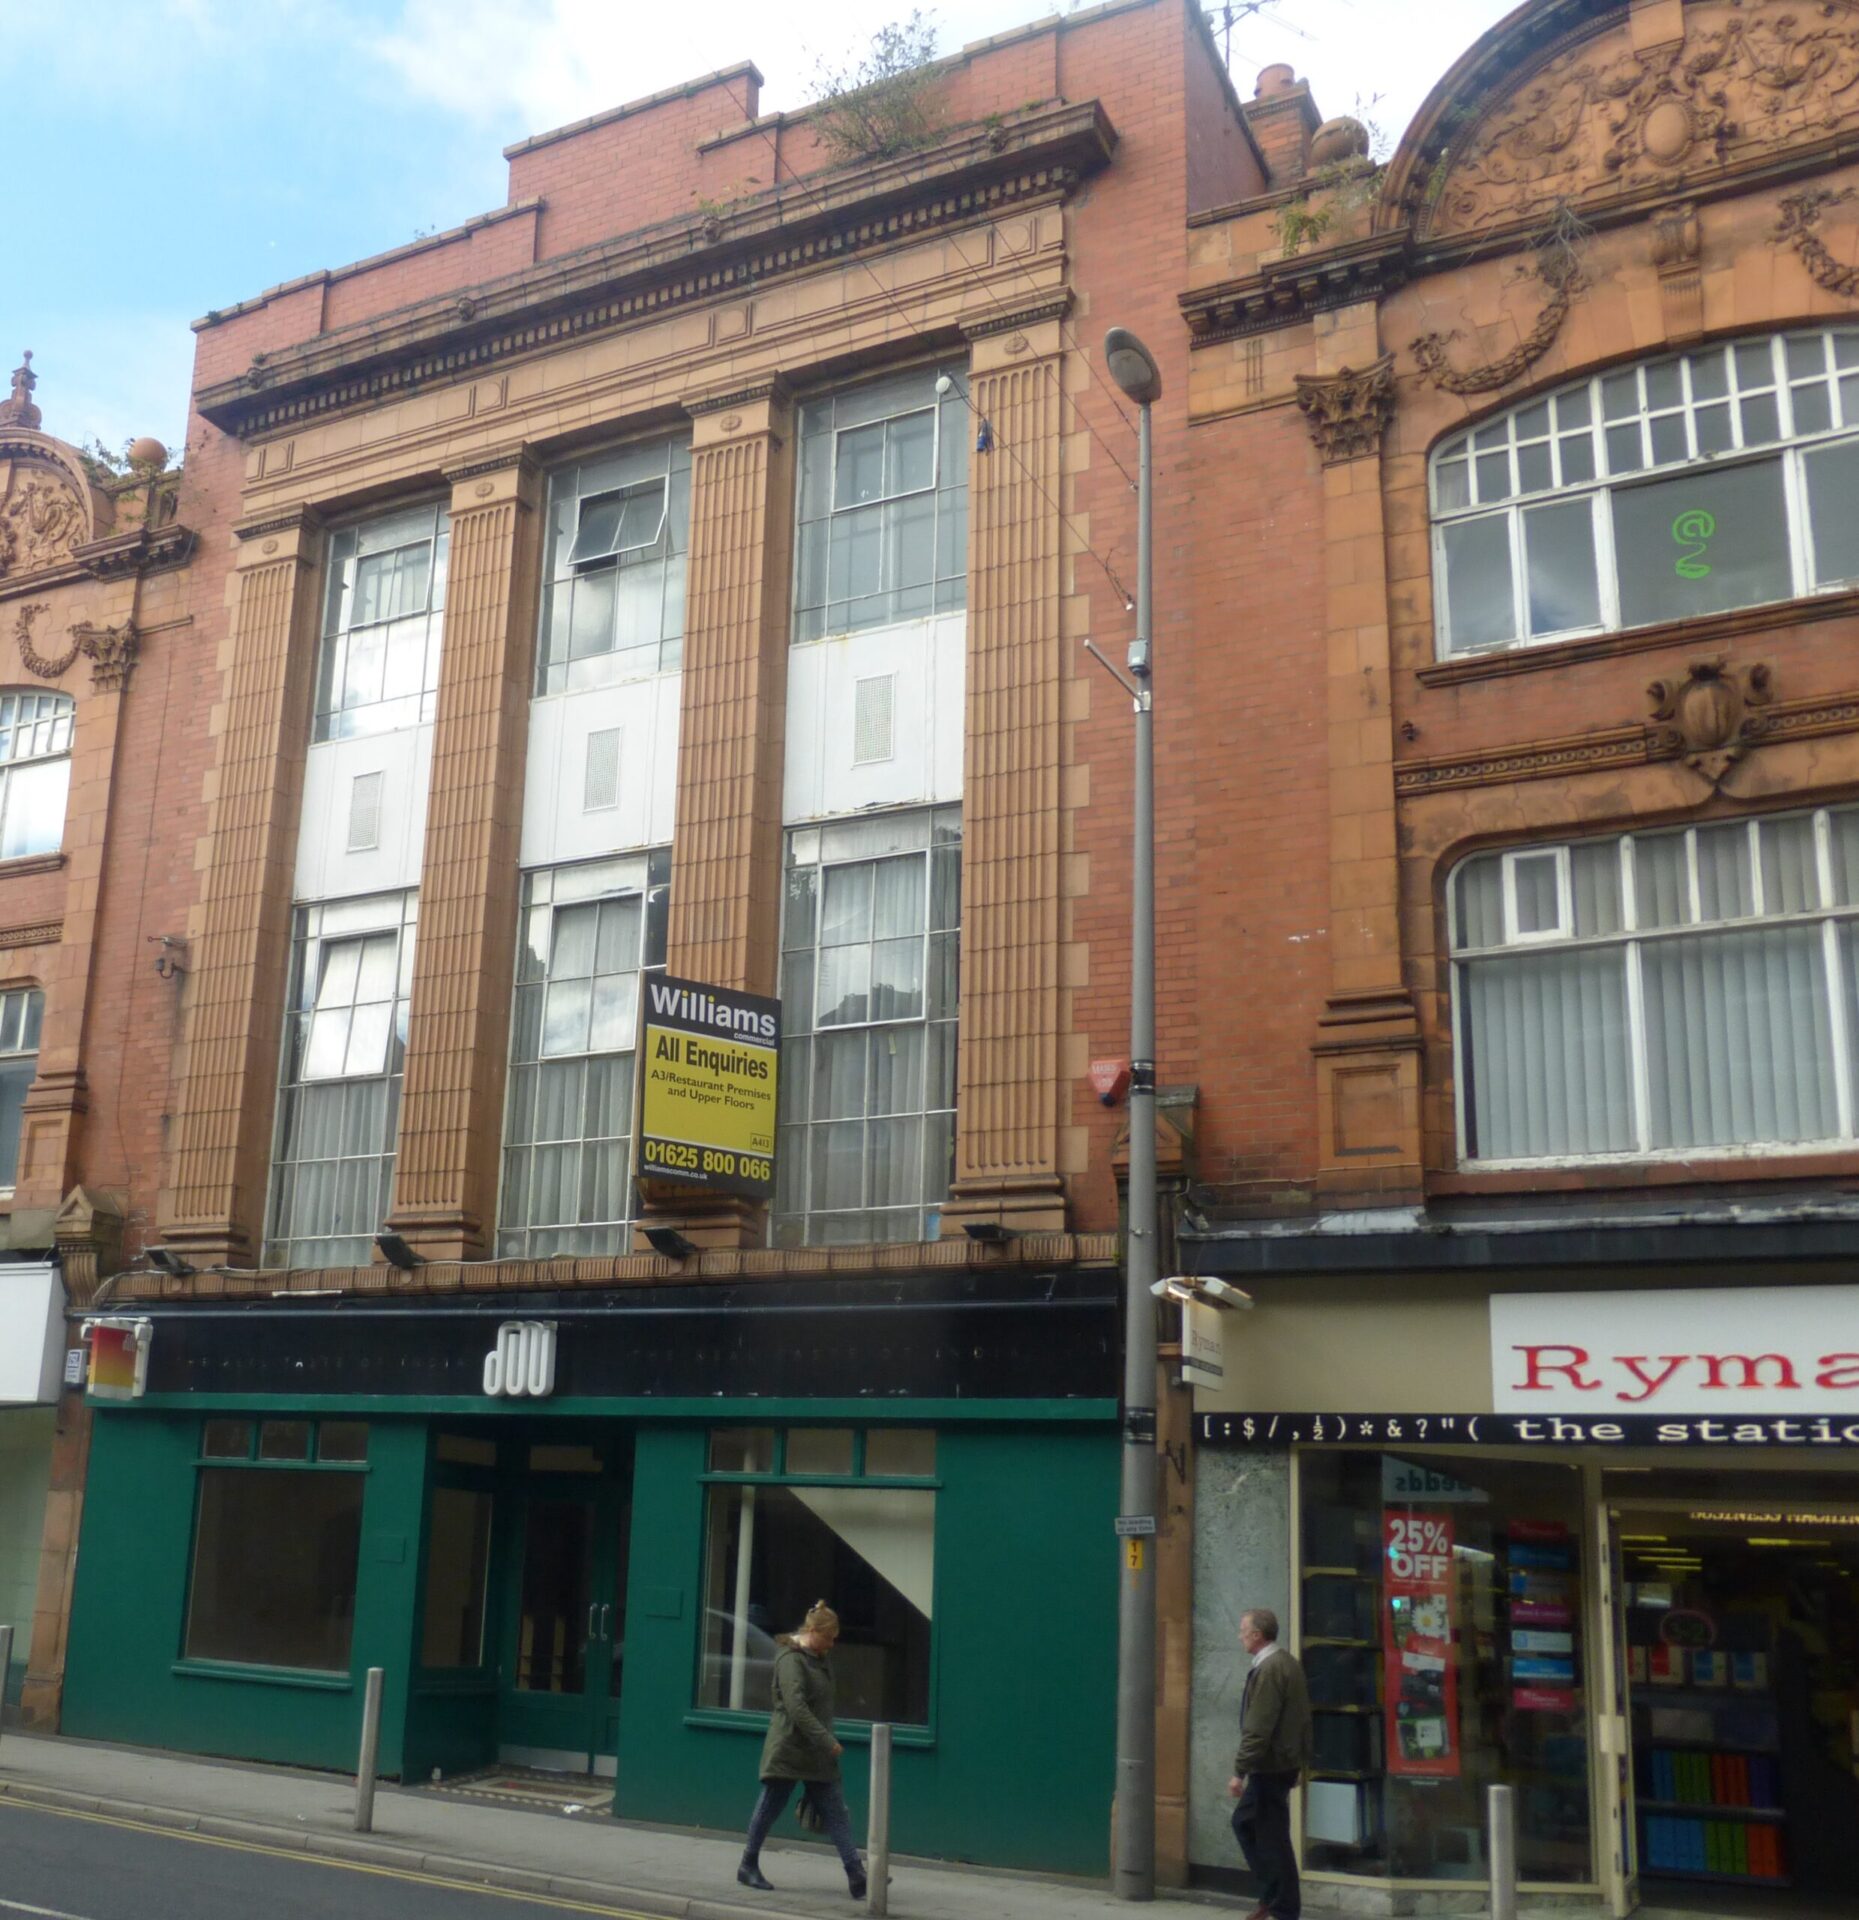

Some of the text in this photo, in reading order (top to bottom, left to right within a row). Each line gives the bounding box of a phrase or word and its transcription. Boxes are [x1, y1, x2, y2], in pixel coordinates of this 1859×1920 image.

[650, 983, 776, 1037] Williams
[734, 1031, 775, 1046] commercial
[655, 1035, 768, 1080] All Enquiries
[651, 1069, 771, 1101] A3/Restaurant Premises
[667, 1085, 755, 1110] and Upper Floors
[643, 1163, 708, 1180] williamscomm.co.uk
[645, 1140, 771, 1181] 01625 800 066
[1513, 1418, 1625, 1441] the
[1389, 1519, 1448, 1554] 25%
[1390, 1552, 1448, 1579] OFF
